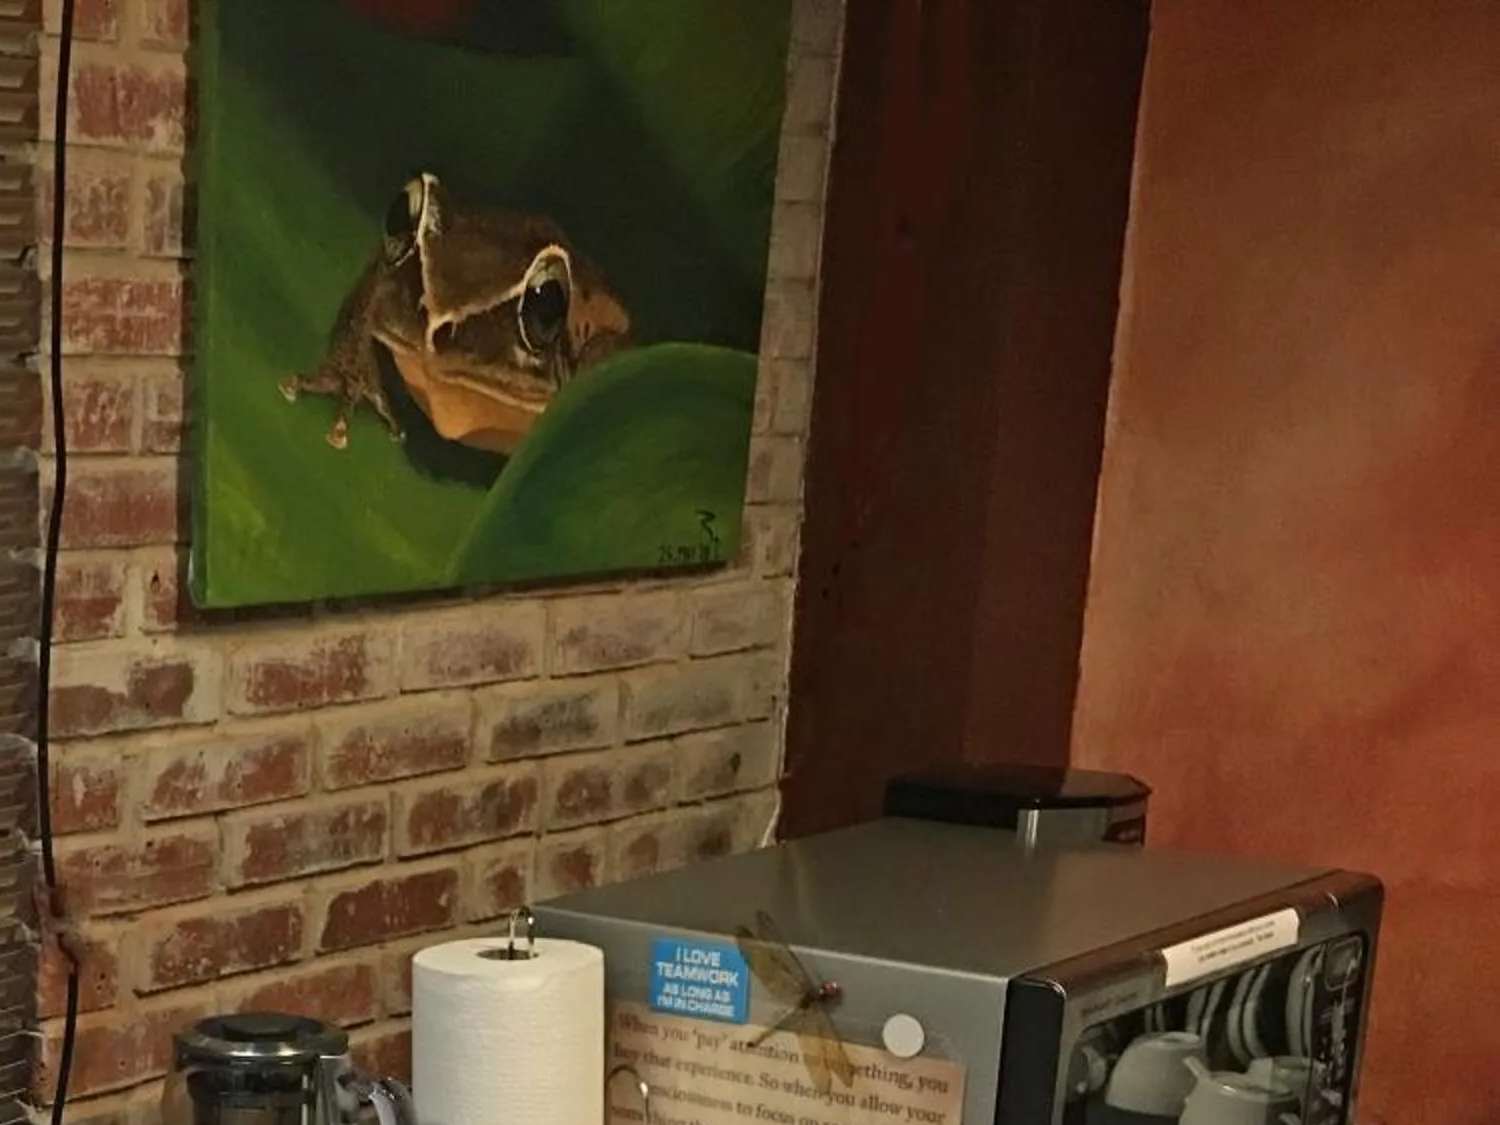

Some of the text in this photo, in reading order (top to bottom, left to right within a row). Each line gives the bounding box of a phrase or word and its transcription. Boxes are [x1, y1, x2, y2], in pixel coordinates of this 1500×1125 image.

[676, 946, 721, 967] I LOVE
[656, 962, 739, 987] TEAMWORK
[662, 983, 731, 1002] AS LONG AS
[661, 1027, 689, 1041] you
[917, 1074, 949, 1094] you
[644, 1052, 672, 1068] that
[759, 1072, 780, 1090] So
[784, 1078, 822, 1098] when
[825, 1091, 855, 1107] you
[860, 1095, 902, 1115] allow
[905, 1105, 947, 1125] your
[736, 1100, 753, 1116] to
[755, 1103, 795, 1124] focus
